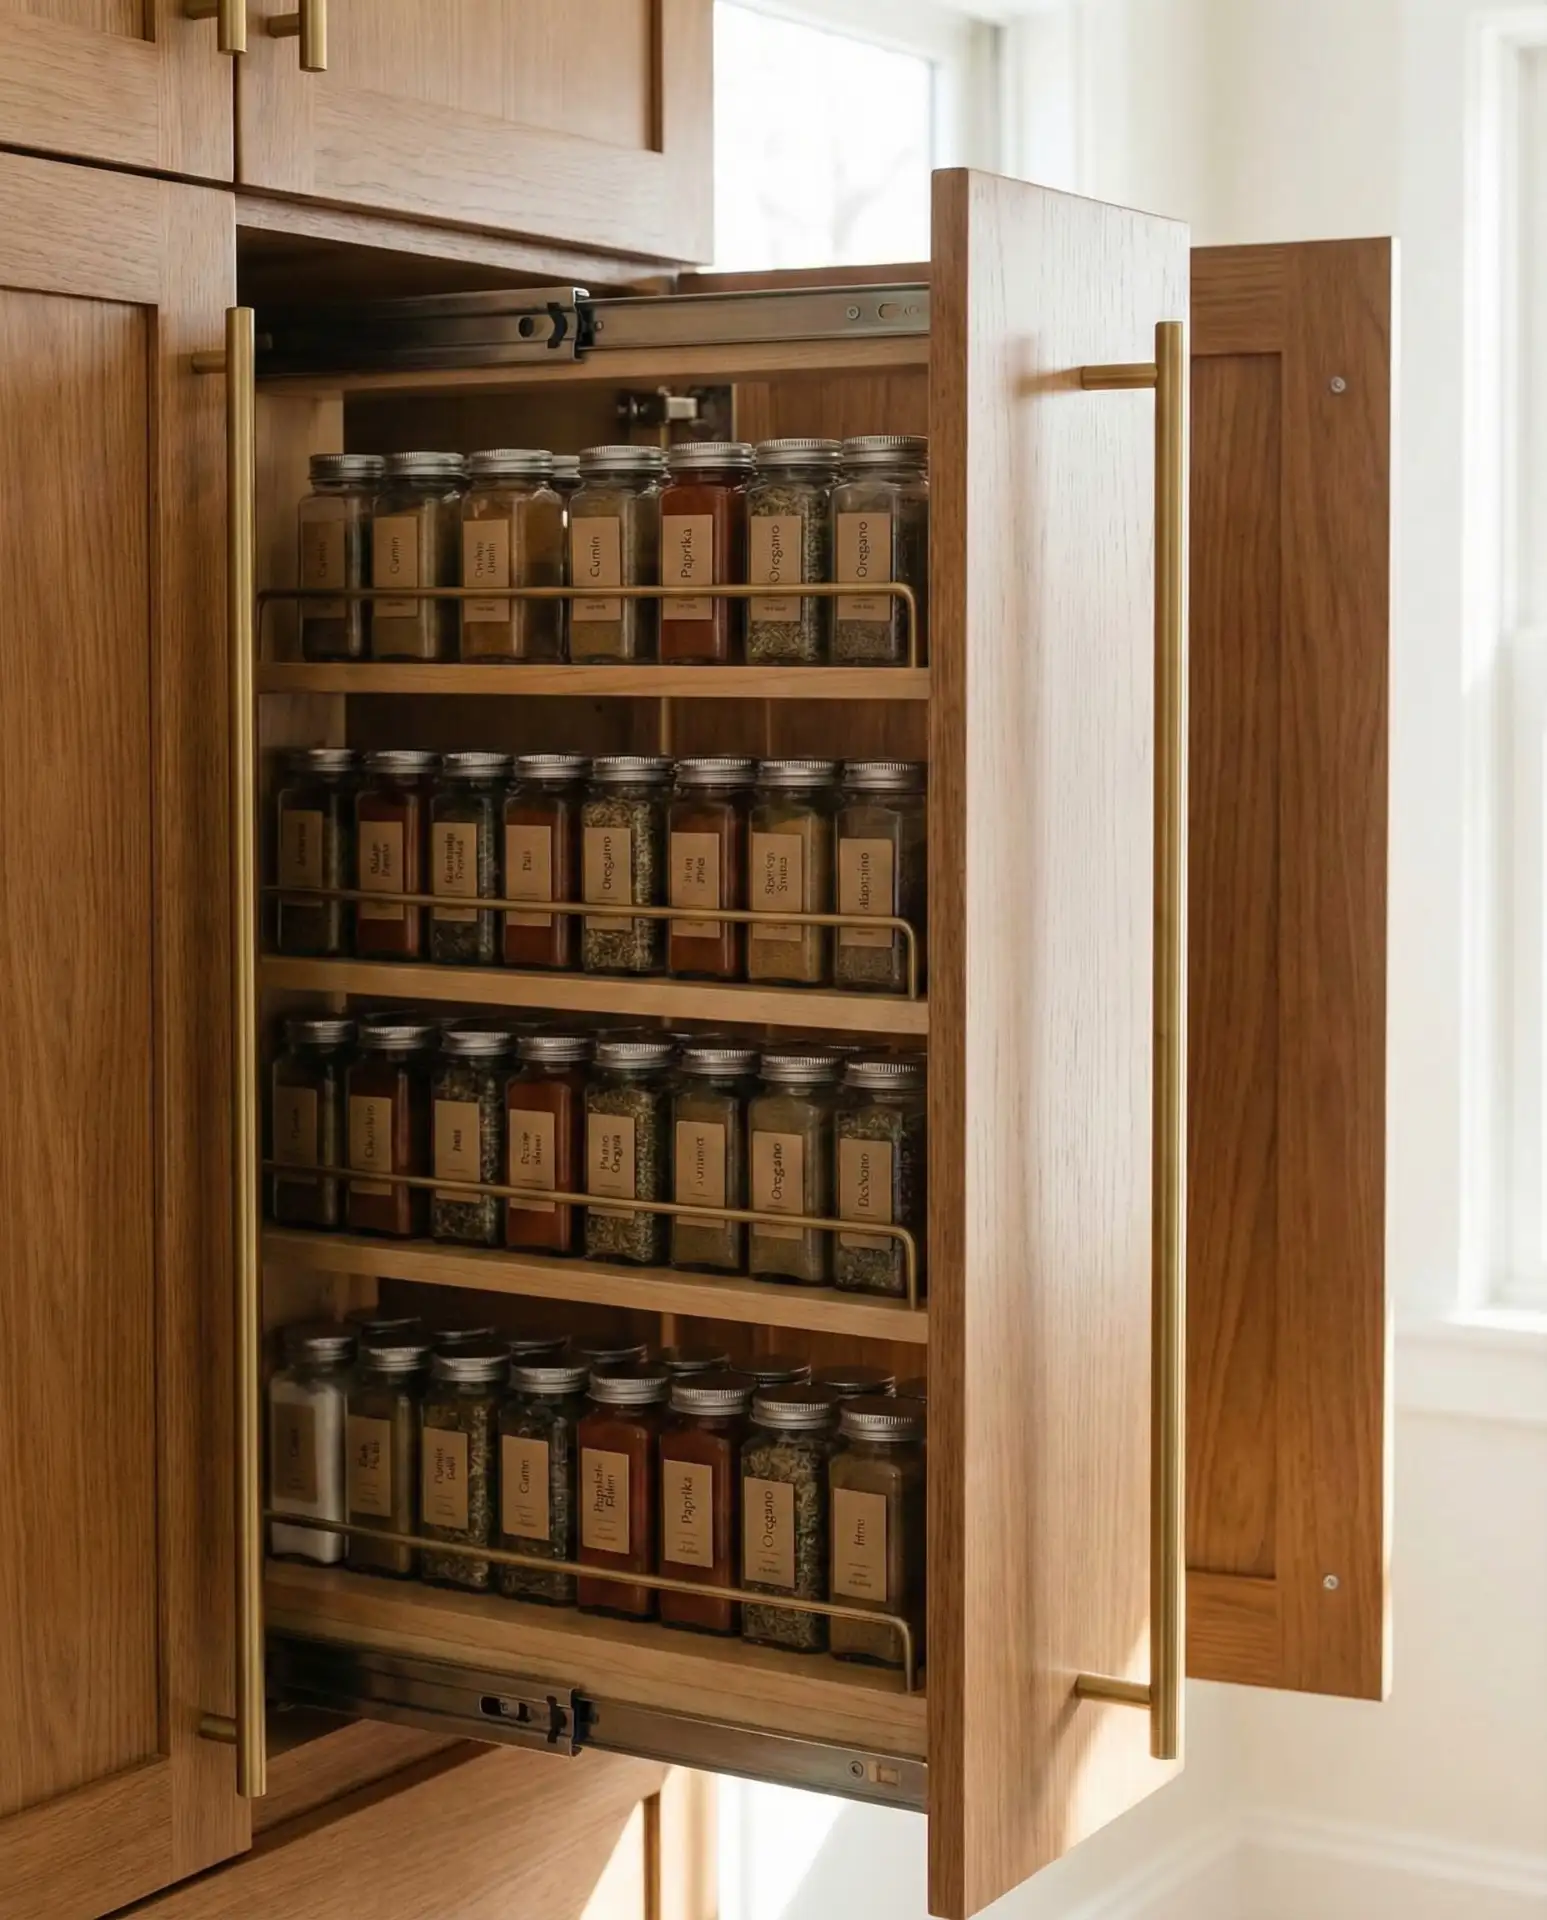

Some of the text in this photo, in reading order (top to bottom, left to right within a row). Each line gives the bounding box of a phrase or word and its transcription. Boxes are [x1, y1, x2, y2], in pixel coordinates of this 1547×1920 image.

[389, 536, 400, 574] Cumin
[590, 536, 600, 578] Cumin
[680, 527, 693, 579] Paprika
[768, 524, 784, 583] Oregano
[855, 520, 871, 578] Oregano
[771, 1142, 786, 1200] Oregano
[682, 1476, 694, 1525] Paprika
[762, 1490, 777, 1548] Oregano
